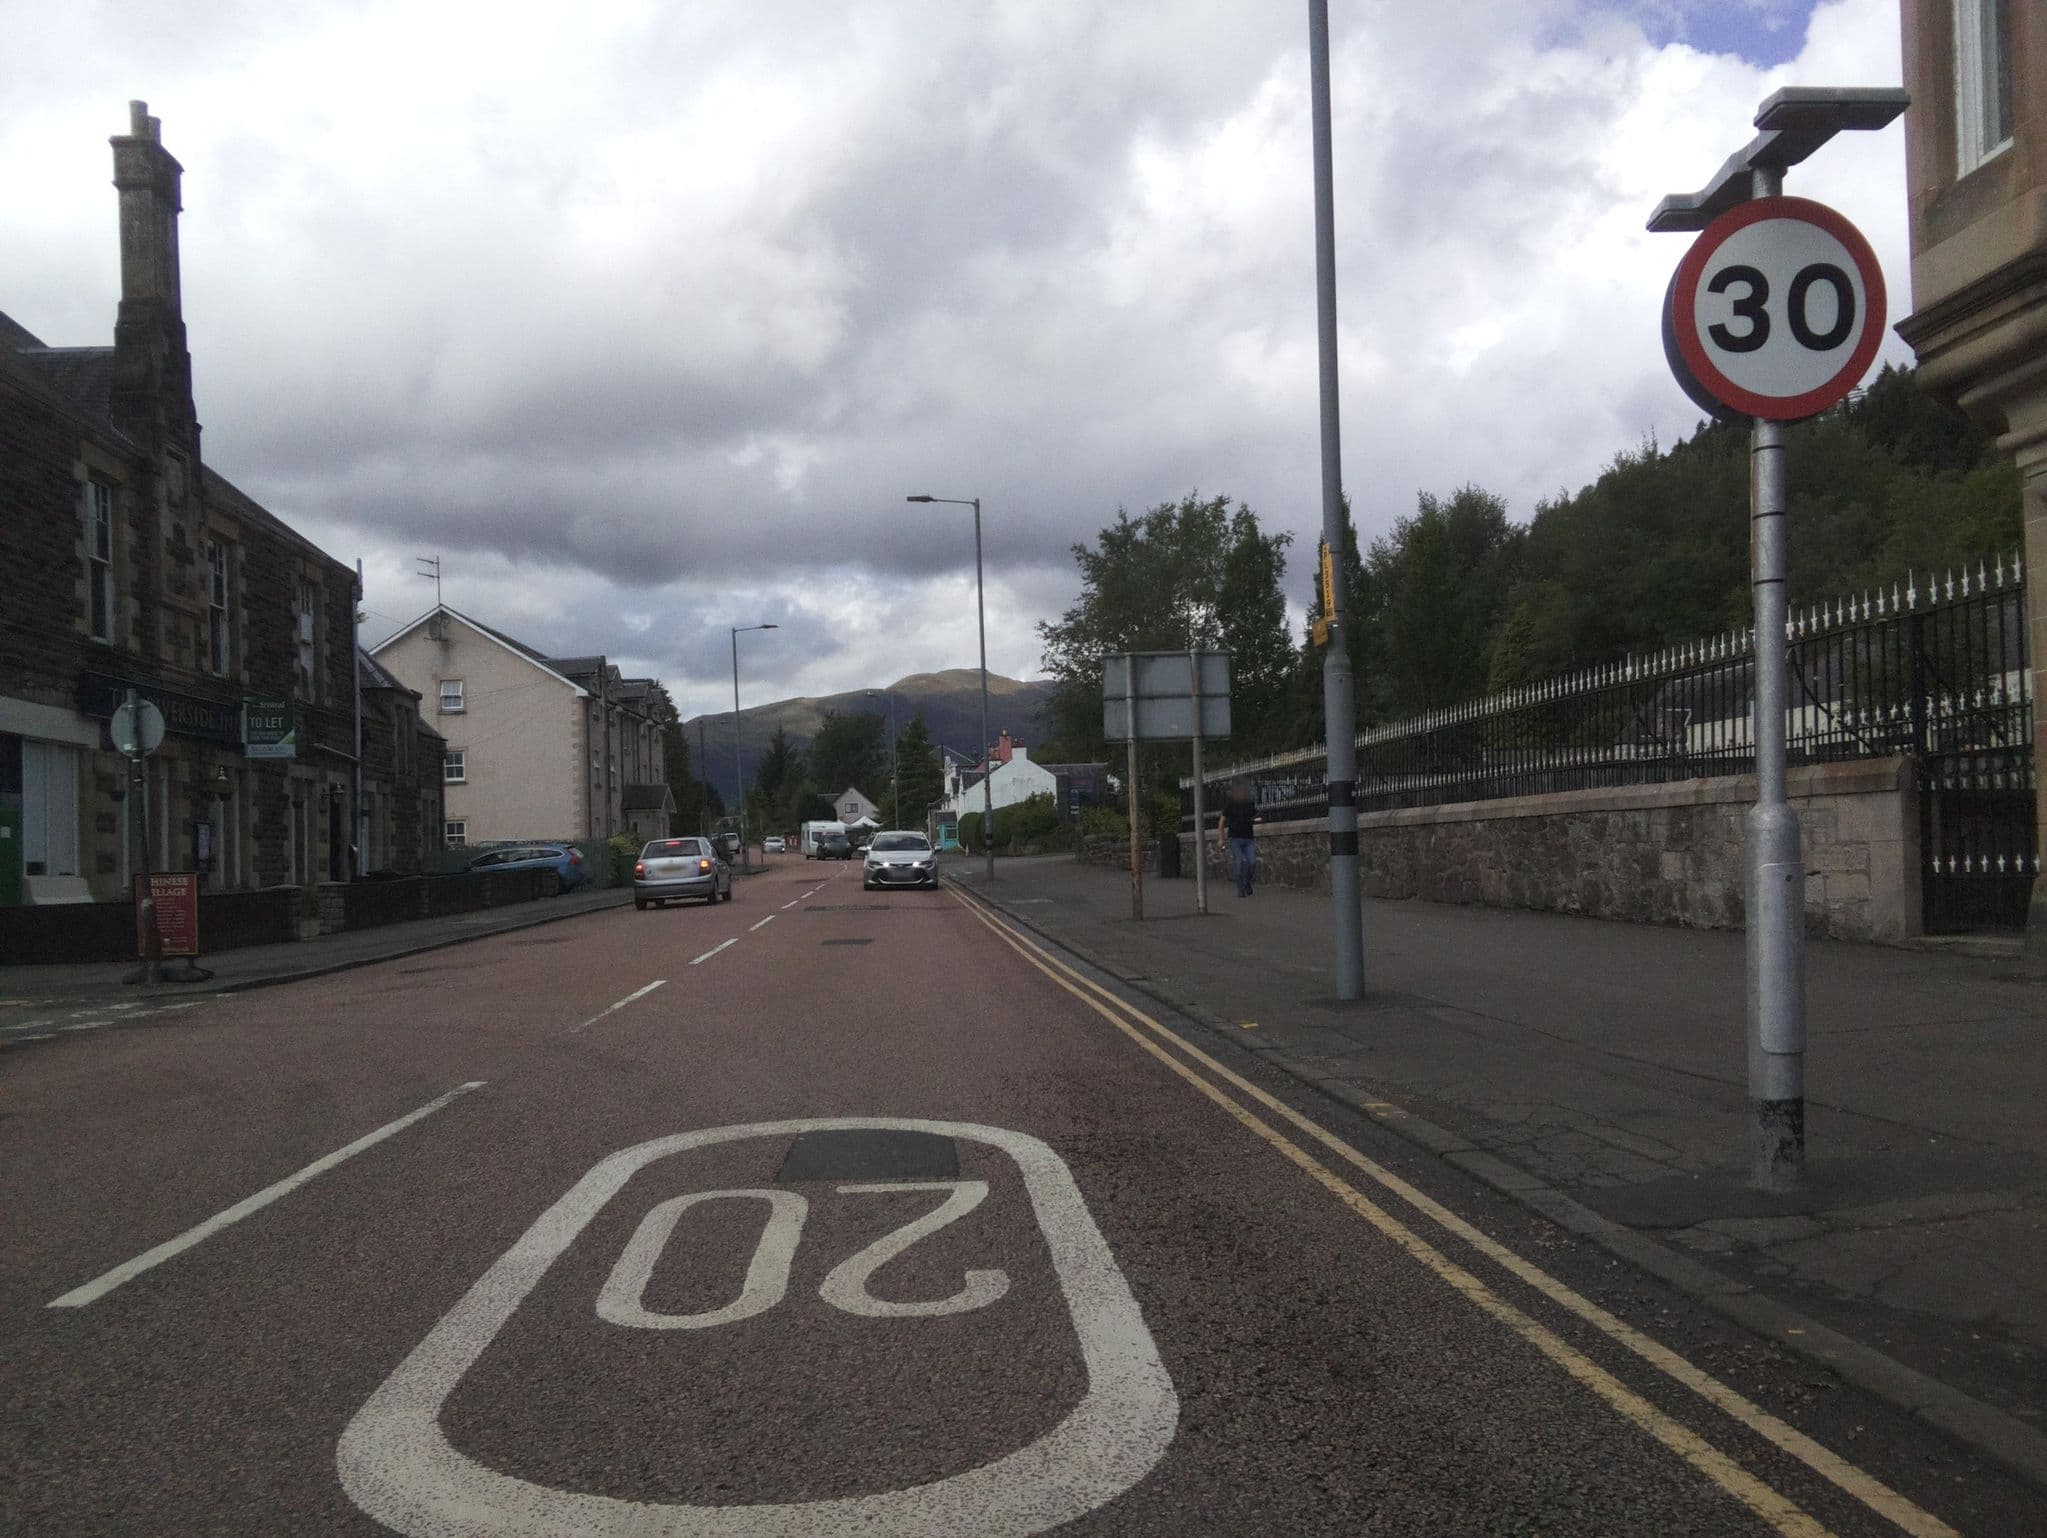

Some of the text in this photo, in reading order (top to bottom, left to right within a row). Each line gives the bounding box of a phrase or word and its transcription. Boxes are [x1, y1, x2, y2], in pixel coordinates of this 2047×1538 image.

[1707, 262, 1856, 354] 30
[248, 716, 283, 729] TO LET
[150, 877, 189, 886] HINESE
[151, 888, 187, 897] ILLAGE
[596, 1180, 1012, 1330] 20
